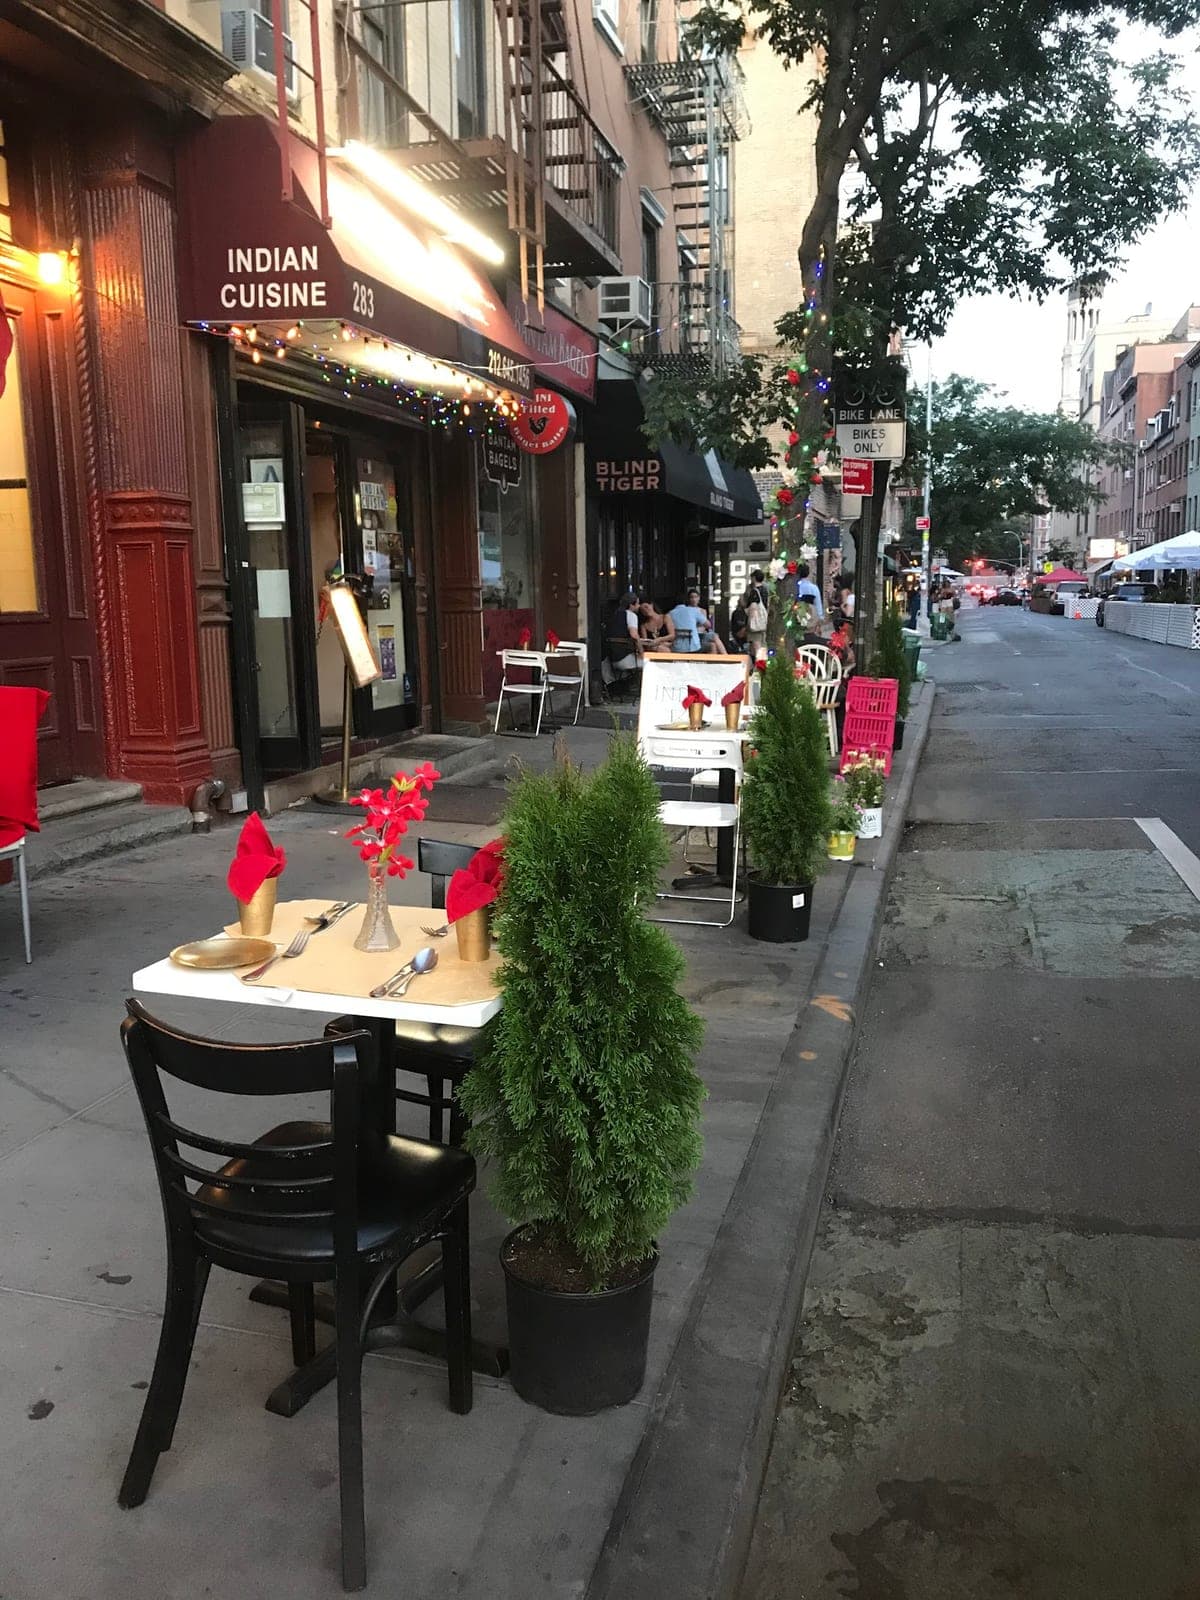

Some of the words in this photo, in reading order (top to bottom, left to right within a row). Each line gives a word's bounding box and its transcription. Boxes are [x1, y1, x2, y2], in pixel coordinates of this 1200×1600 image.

[228, 245, 318, 273] INDIAN
[220, 281, 327, 309] CUISINE
[352, 281, 375, 319] 283
[559, 333, 589, 379] BAGELS
[535, 393, 552, 403] INI
[522, 404, 556, 414] Filled
[839, 409, 865, 421] BIKE
[869, 408, 901, 420] LANE
[852, 428, 886, 440] BIKES
[853, 442, 884, 454] ONLY
[488, 450, 517, 471] BAGELS
[595, 459, 661, 476] BLIND
[263, 465, 280, 483] A
[595, 476, 660, 492] TIGER
[361, 495, 388, 511] CUISINE
